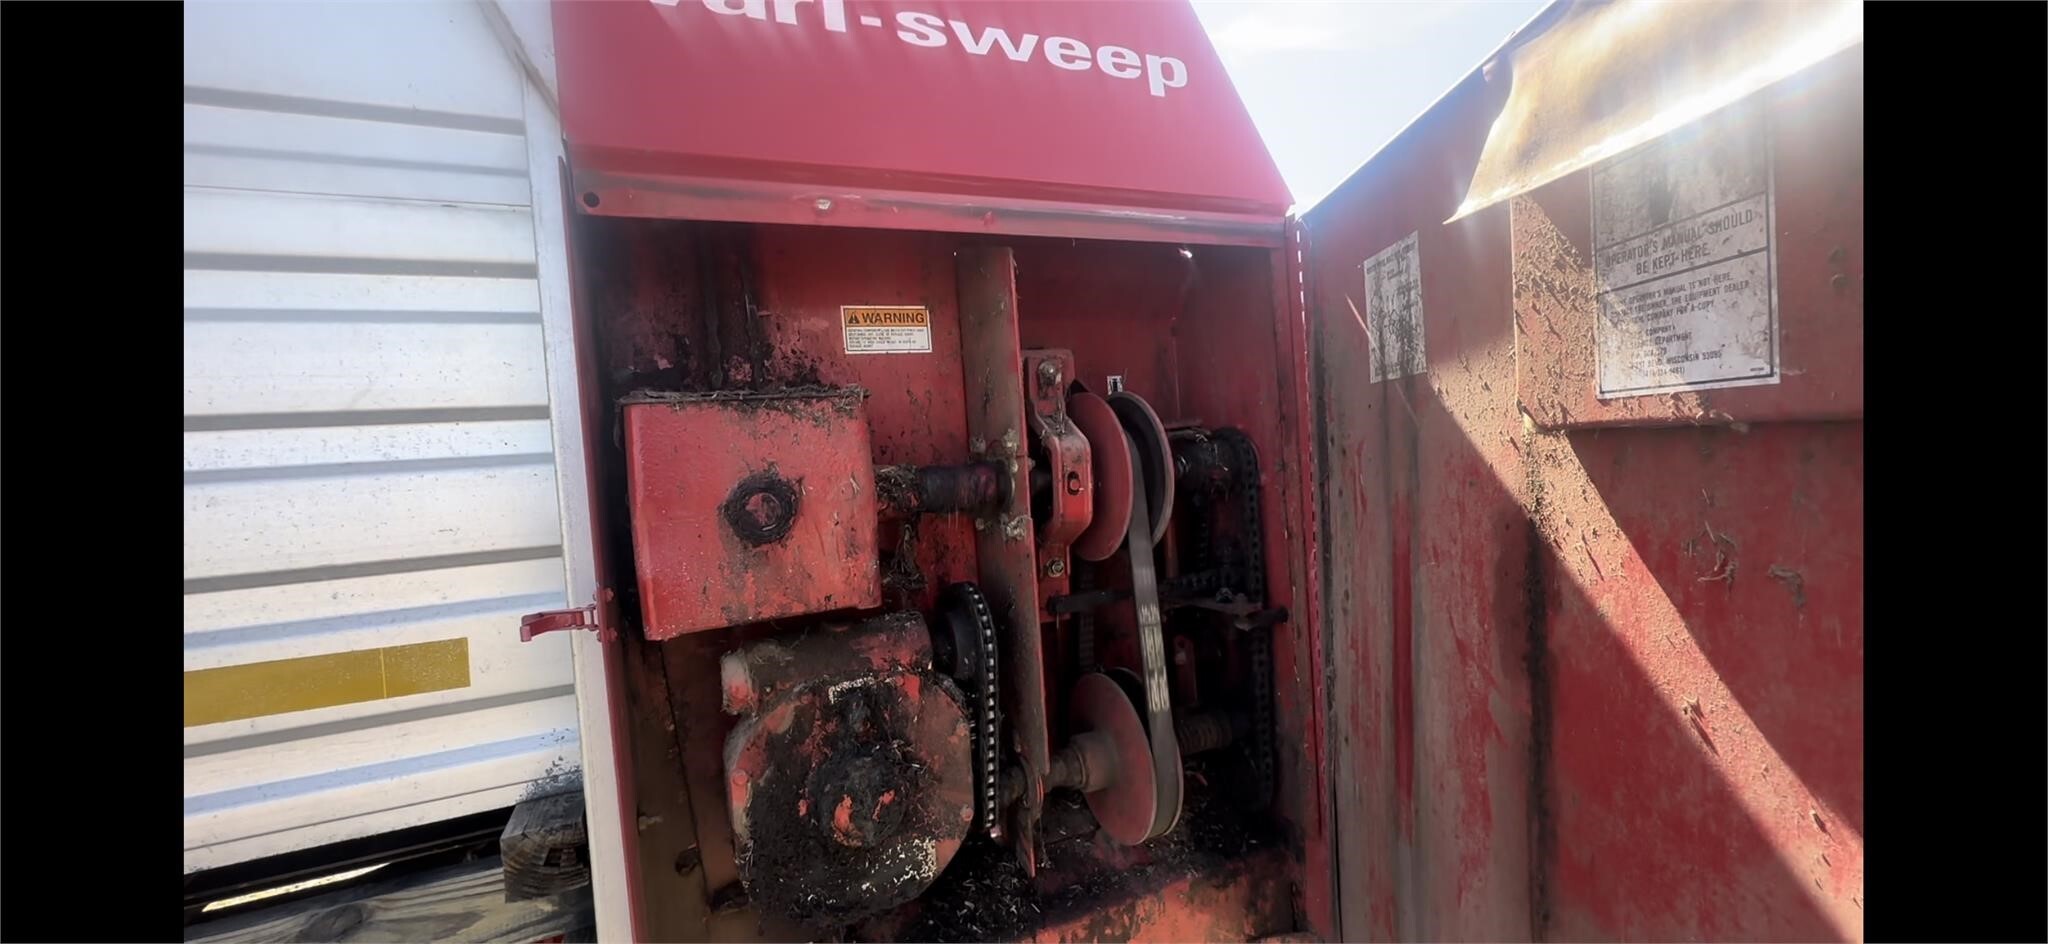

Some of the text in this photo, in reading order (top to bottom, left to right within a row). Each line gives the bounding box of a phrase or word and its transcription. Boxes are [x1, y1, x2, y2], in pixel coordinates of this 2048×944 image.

[1606, 209, 1753, 267] OPERATOR'S MANUAL SHOULD
[1635, 261, 1648, 275] BE
[1652, 251, 1675, 271] KEPT
[1723, 280, 1750, 293] DEALER
[861, 313, 924, 324] WARNING
